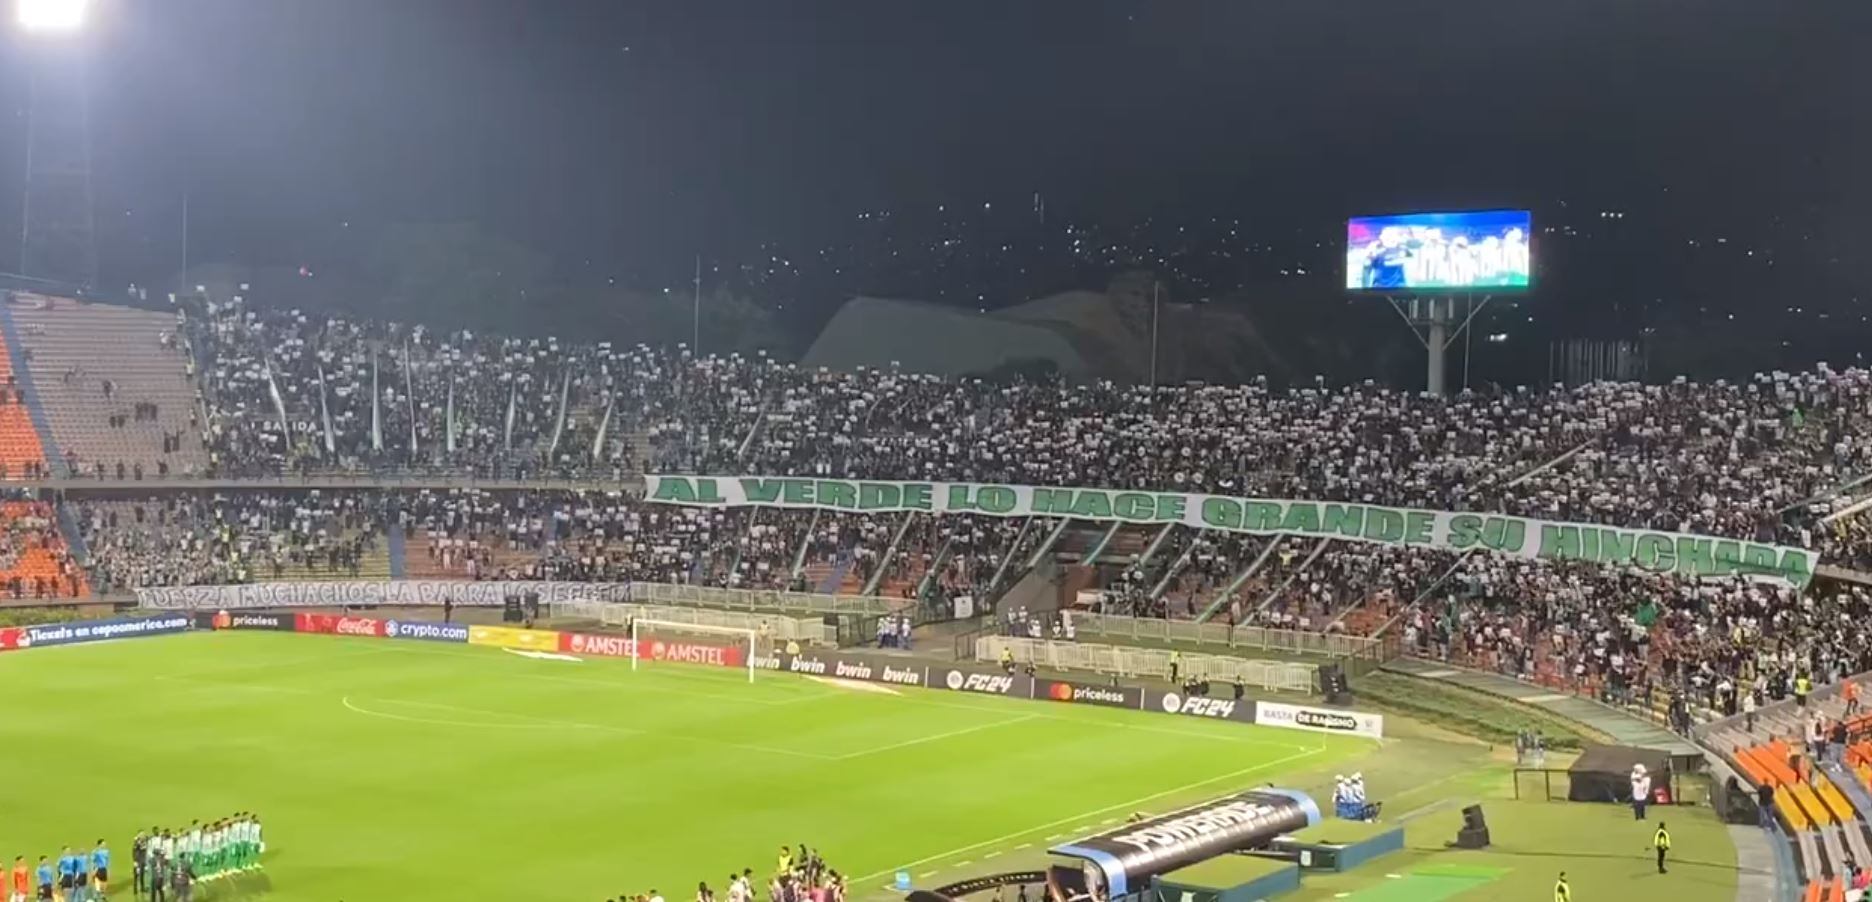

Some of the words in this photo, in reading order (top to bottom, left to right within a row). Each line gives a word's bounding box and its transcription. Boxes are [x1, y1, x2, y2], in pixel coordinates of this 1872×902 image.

[263, 421, 317, 432] SAIDA
[652, 477, 726, 503] AL
[739, 478, 933, 510] VERDE
[947, 484, 1016, 513] LO
[1031, 489, 1186, 520] HACE
[1201, 498, 1434, 542] GRANDE
[1448, 514, 1525, 553] SU
[1536, 524, 1811, 585] HINCHADA
[138, 587, 227, 609] FUERZA
[241, 582, 378, 605] MUCHACHOS
[387, 581, 411, 603] LA
[418, 582, 495, 602] BARRA
[233, 616, 279, 627] priceless
[76, 626, 90, 637] en
[401, 624, 467, 640] crypto.com
[667, 645, 725, 665] AMSTEL
[791, 655, 825, 674] bwin
[836, 661, 871, 679] bwin
[883, 665, 919, 684] bwin
[1073, 687, 1125, 702] priceless
